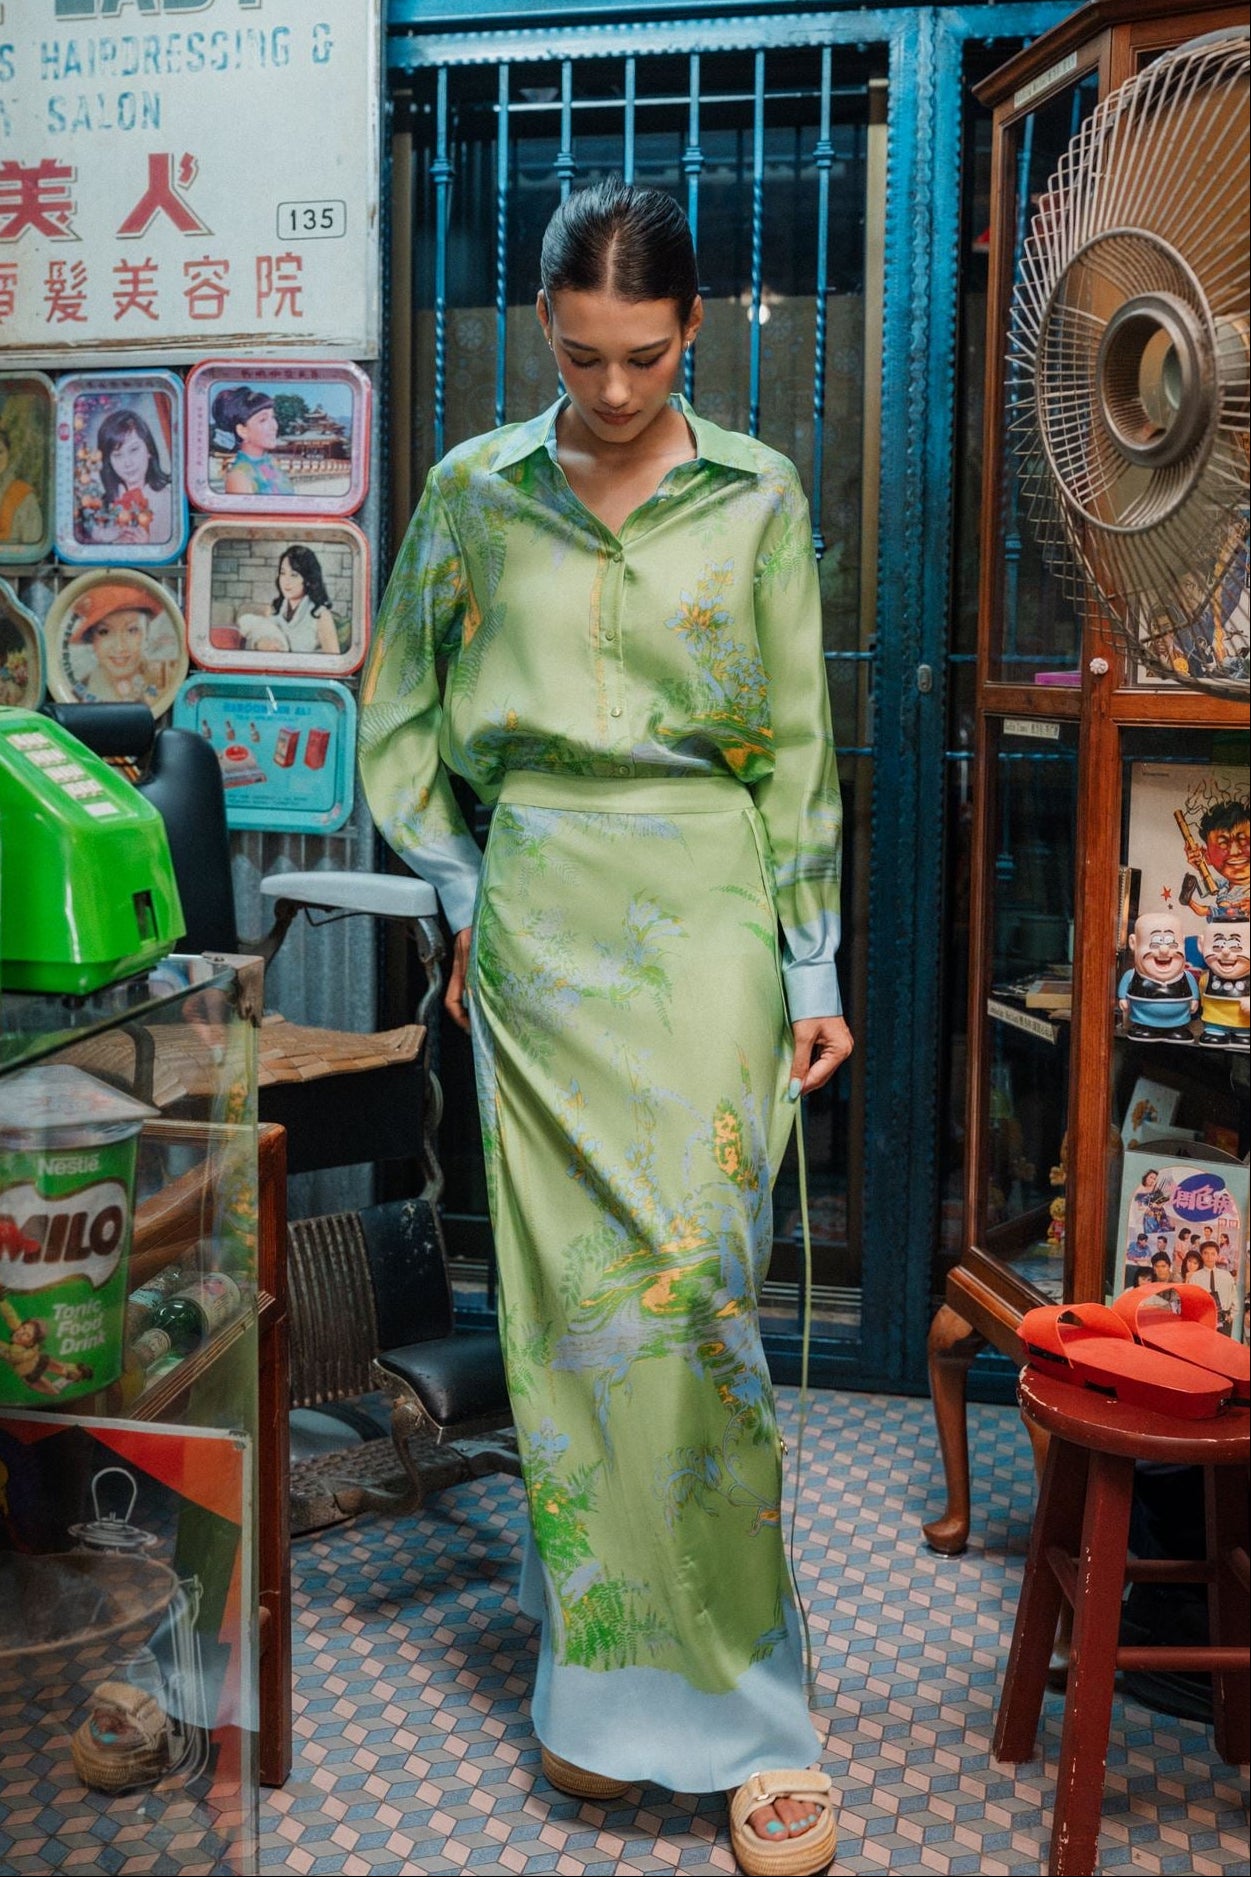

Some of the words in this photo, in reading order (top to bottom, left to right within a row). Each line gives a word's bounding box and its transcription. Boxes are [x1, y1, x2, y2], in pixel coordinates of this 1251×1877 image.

[47, 92, 161, 133] SALON
[289, 208, 335, 232] 135
[0, 1204, 123, 1264] MILO
[52, 1297, 102, 1320] Tonic
[56, 1311, 105, 1338] Food
